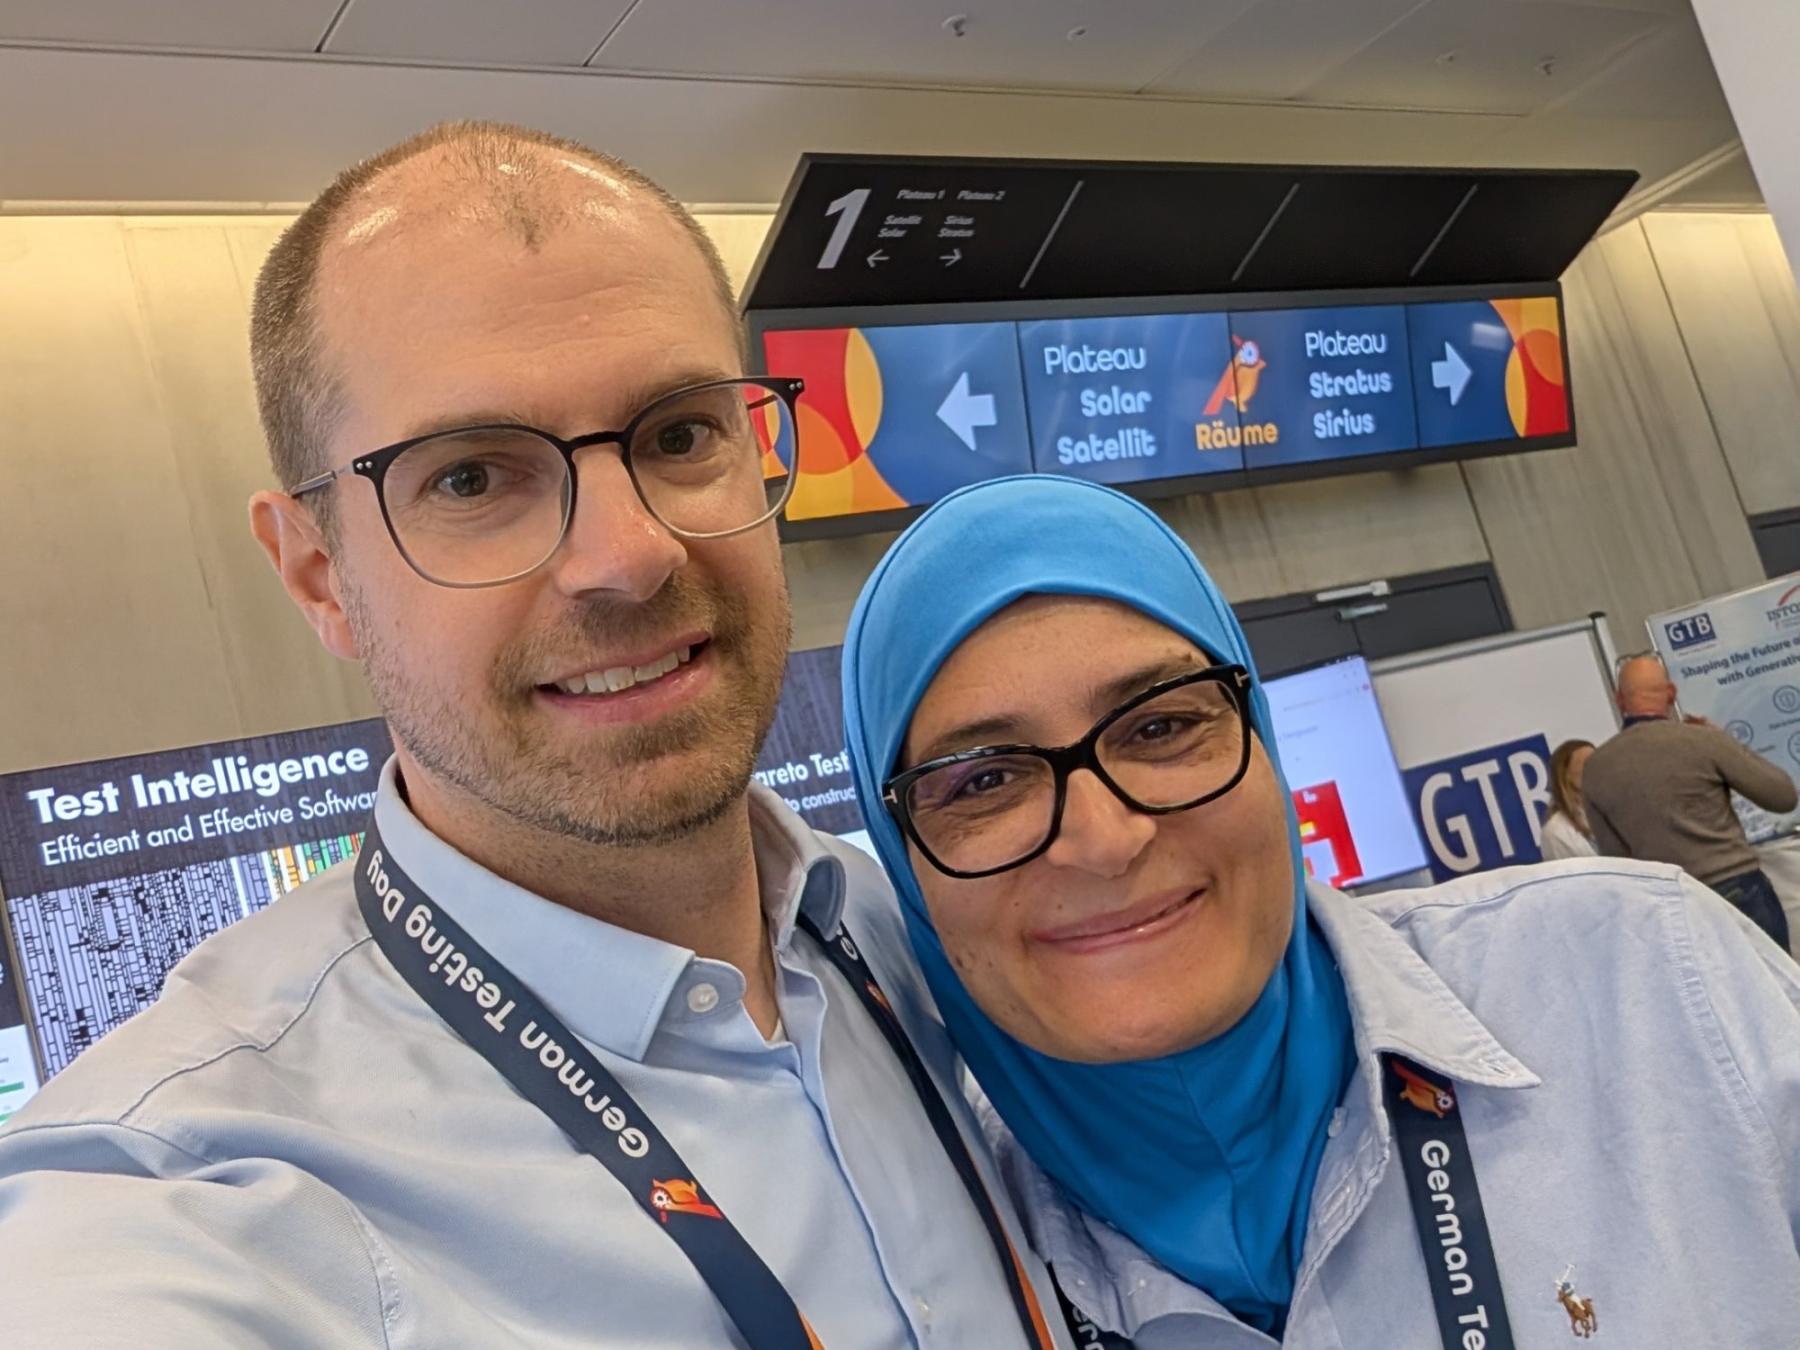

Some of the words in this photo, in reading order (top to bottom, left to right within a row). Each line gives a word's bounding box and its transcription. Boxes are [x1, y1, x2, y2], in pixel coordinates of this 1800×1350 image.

[896, 189, 937, 200] Plateau
[937, 189, 946, 200] 1
[957, 190, 995, 200] Plateau
[994, 190, 1006, 200] 2
[817, 188, 872, 269] 1
[878, 228, 907, 238] Solar
[884, 215, 922, 225] Satellit
[937, 228, 974, 238] Stratus
[944, 215, 974, 225] Sirius
[1043, 345, 1147, 375] Plateau
[1305, 331, 1387, 358] Plateau
[1308, 370, 1393, 400] Stratus
[1080, 386, 1152, 418] Solar
[1195, 420, 1279, 451] Räume
[1313, 407, 1376, 440] Sirius
[1056, 427, 1157, 466] Satellit
[1668, 615, 1711, 643] GTB
[1681, 657, 1730, 679] Shaping
[1730, 651, 1751, 664] the
[1751, 639, 1791, 657] Future
[1717, 669, 1744, 685] with
[754, 762, 809, 787] areto
[809, 749, 850, 778] Test
[28, 781, 120, 824] Test
[132, 746, 370, 809] Intelligence
[801, 785, 856, 810] construc
[41, 832, 141, 866] Efficient
[146, 815, 194, 848] and
[199, 803, 294, 839] Effective
[298, 788, 377, 820] Softwar
[366, 850, 406, 922] Day
[404, 904, 517, 1033] Testing
[519, 1020, 650, 1158] German
[1420, 1139, 1474, 1296] German
[1458, 1304, 1490, 1350] Te
